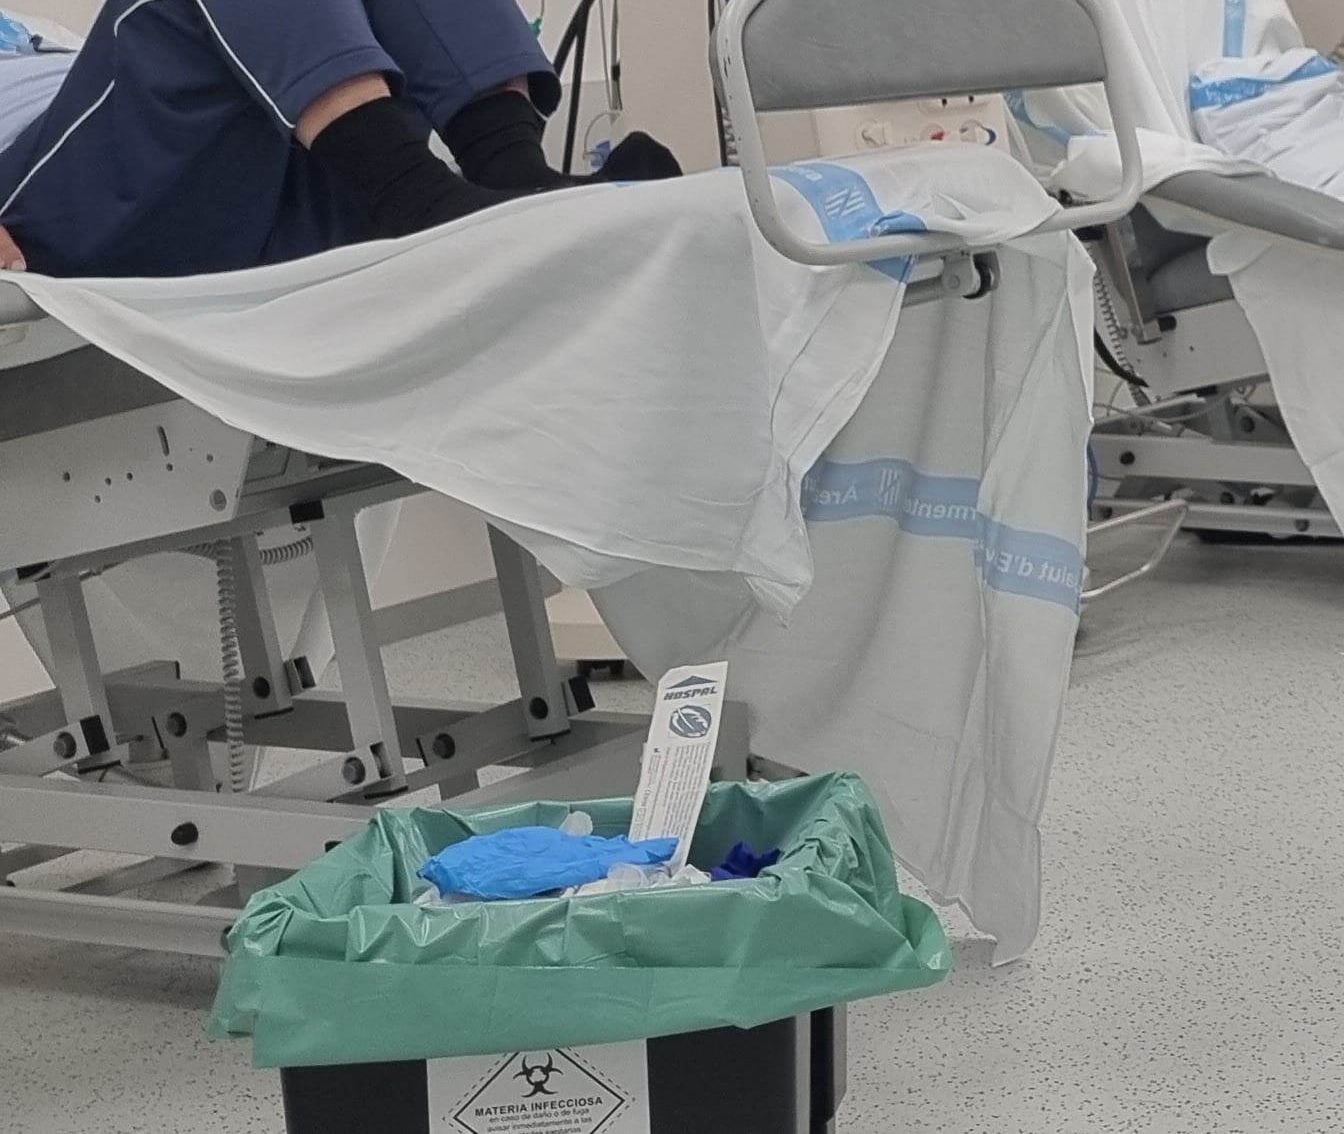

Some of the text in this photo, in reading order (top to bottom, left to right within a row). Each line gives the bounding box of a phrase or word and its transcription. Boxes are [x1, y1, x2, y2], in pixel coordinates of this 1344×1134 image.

[663, 685, 718, 701] HOSPAL
[475, 1097, 603, 1117] MATERIA INFECCIOSA
[572, 1107, 590, 1116] fuga
